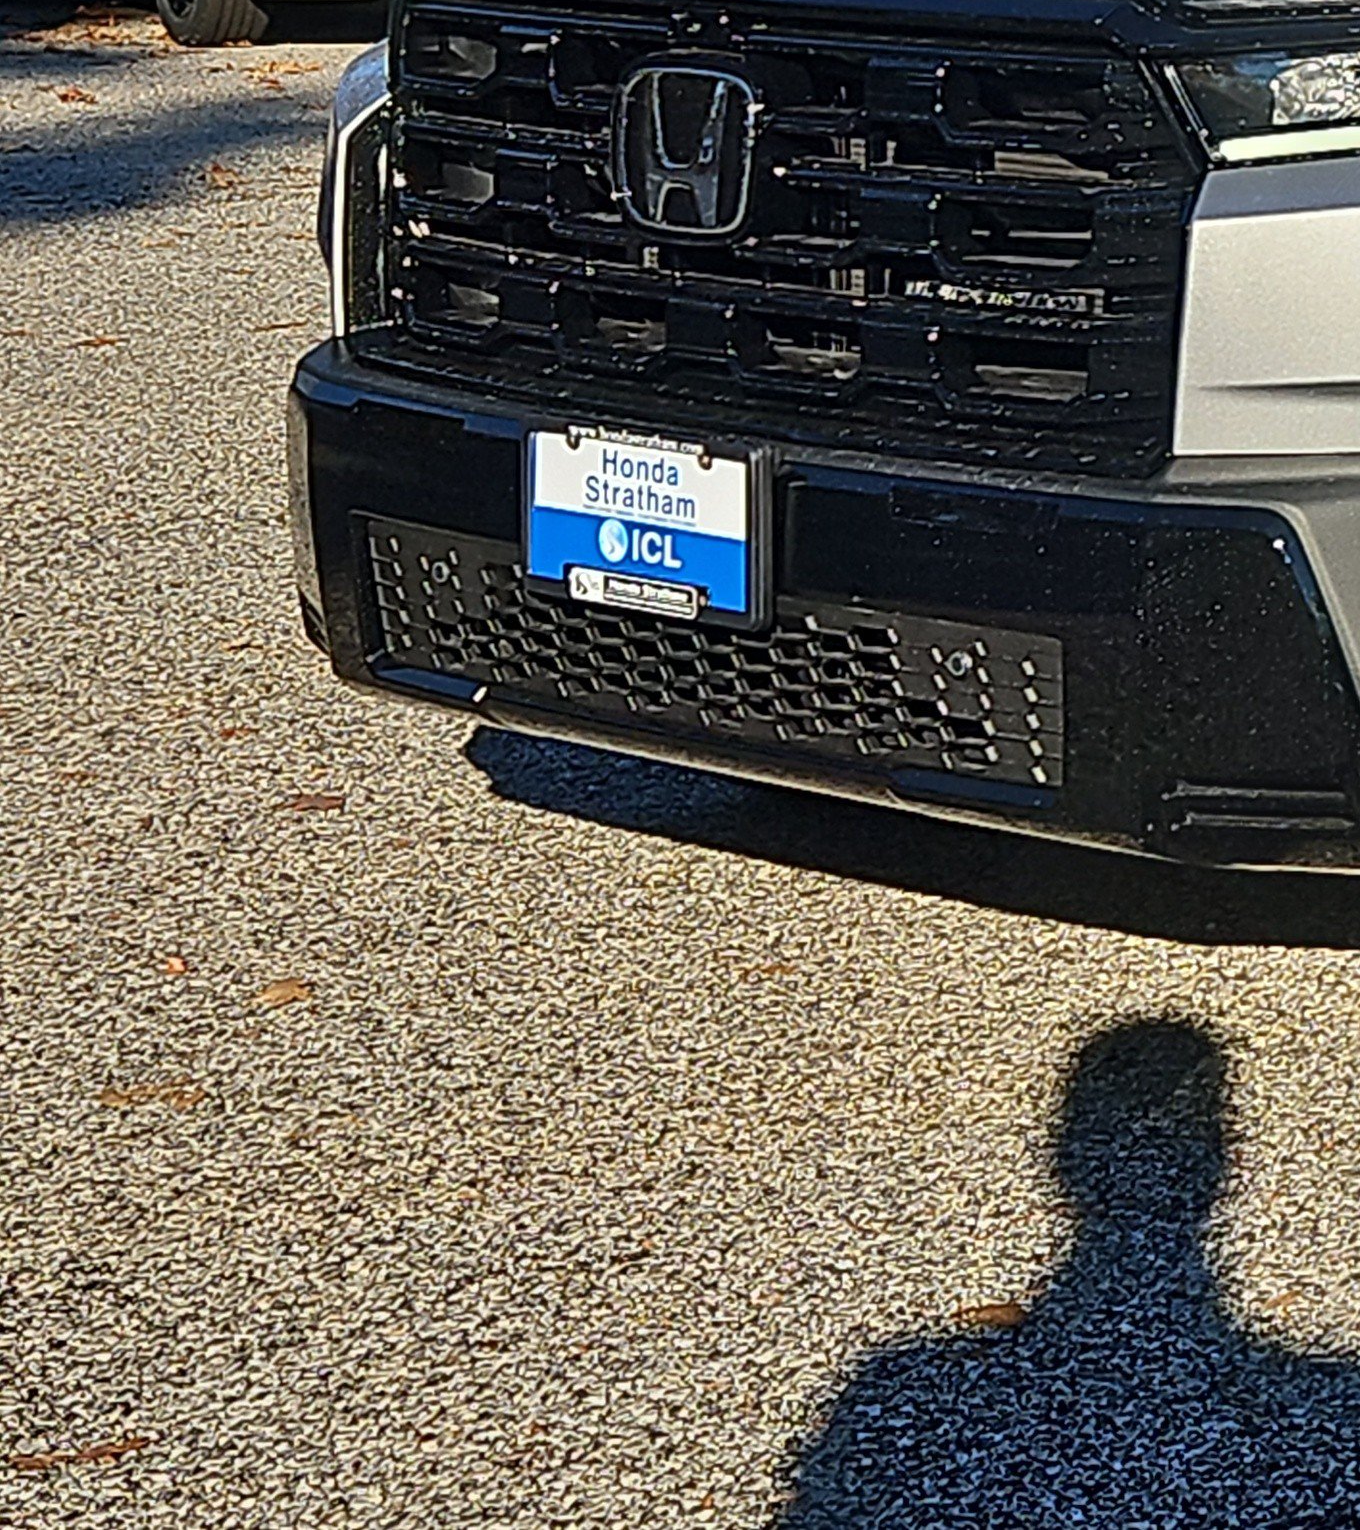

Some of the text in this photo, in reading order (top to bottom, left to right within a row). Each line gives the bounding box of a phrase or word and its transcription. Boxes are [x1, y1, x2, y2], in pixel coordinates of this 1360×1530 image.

[601, 448, 680, 487] Honda
[584, 474, 696, 520] Stratham
[631, 527, 683, 570] ICL
